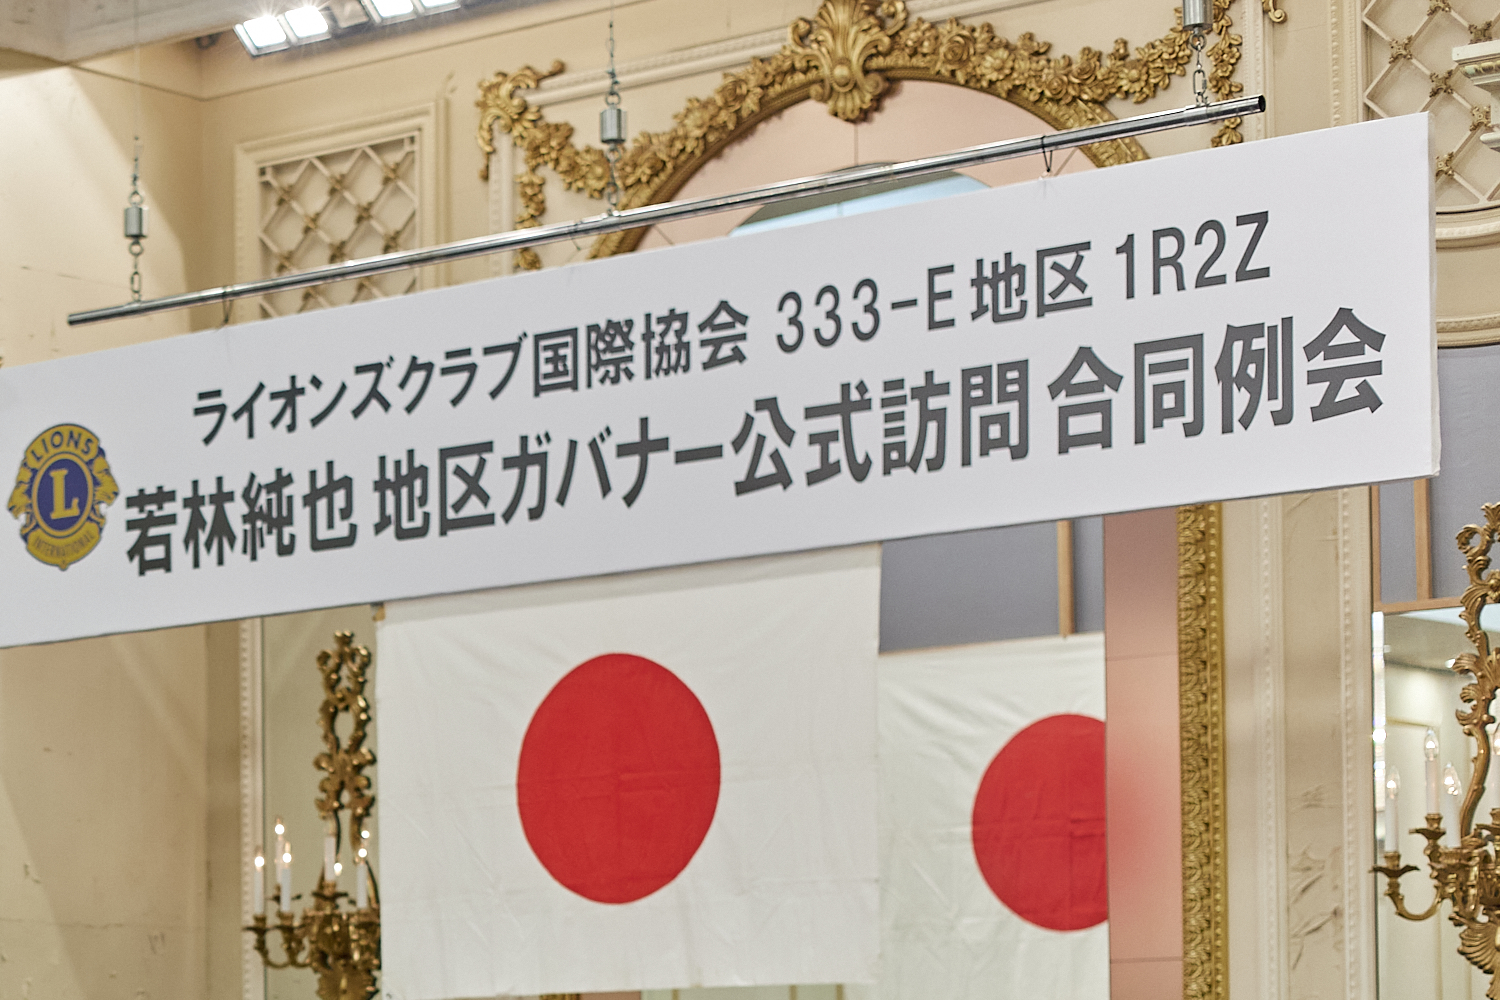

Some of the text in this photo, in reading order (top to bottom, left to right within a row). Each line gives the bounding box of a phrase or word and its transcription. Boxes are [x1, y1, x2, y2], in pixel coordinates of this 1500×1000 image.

[193, 299, 749, 445] ライオンズクラブ国際協会
[1115, 210, 1271, 299] 1R2Z
[30, 430, 94, 463] LIONS
[50, 469, 81, 520] L
[125, 460, 358, 577] 若林純也
